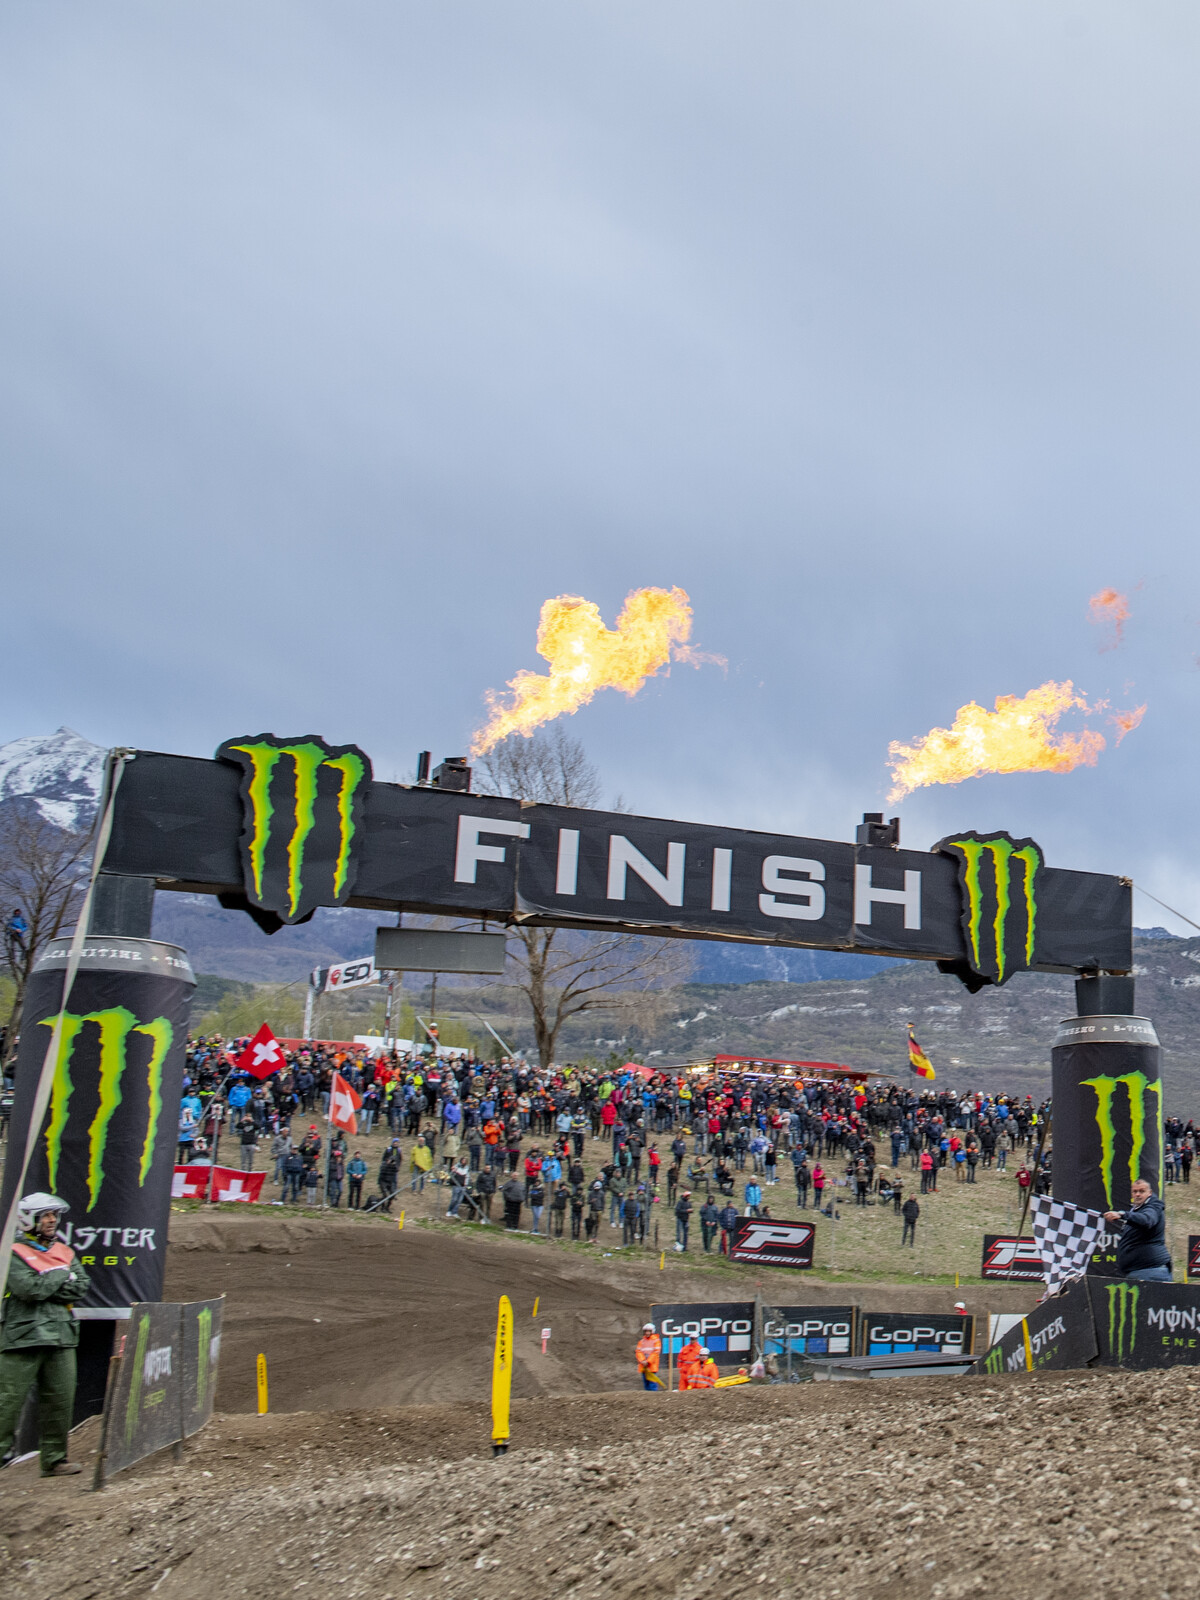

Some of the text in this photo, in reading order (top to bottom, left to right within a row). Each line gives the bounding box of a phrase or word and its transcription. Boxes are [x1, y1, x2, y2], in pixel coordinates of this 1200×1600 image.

[454, 815, 921, 930] FINISH
[734, 1252, 810, 1264] PROGRIP
[661, 1317, 751, 1336] GoPro
[763, 1320, 850, 1337] GoPro
[869, 1326, 964, 1344] GoPro
